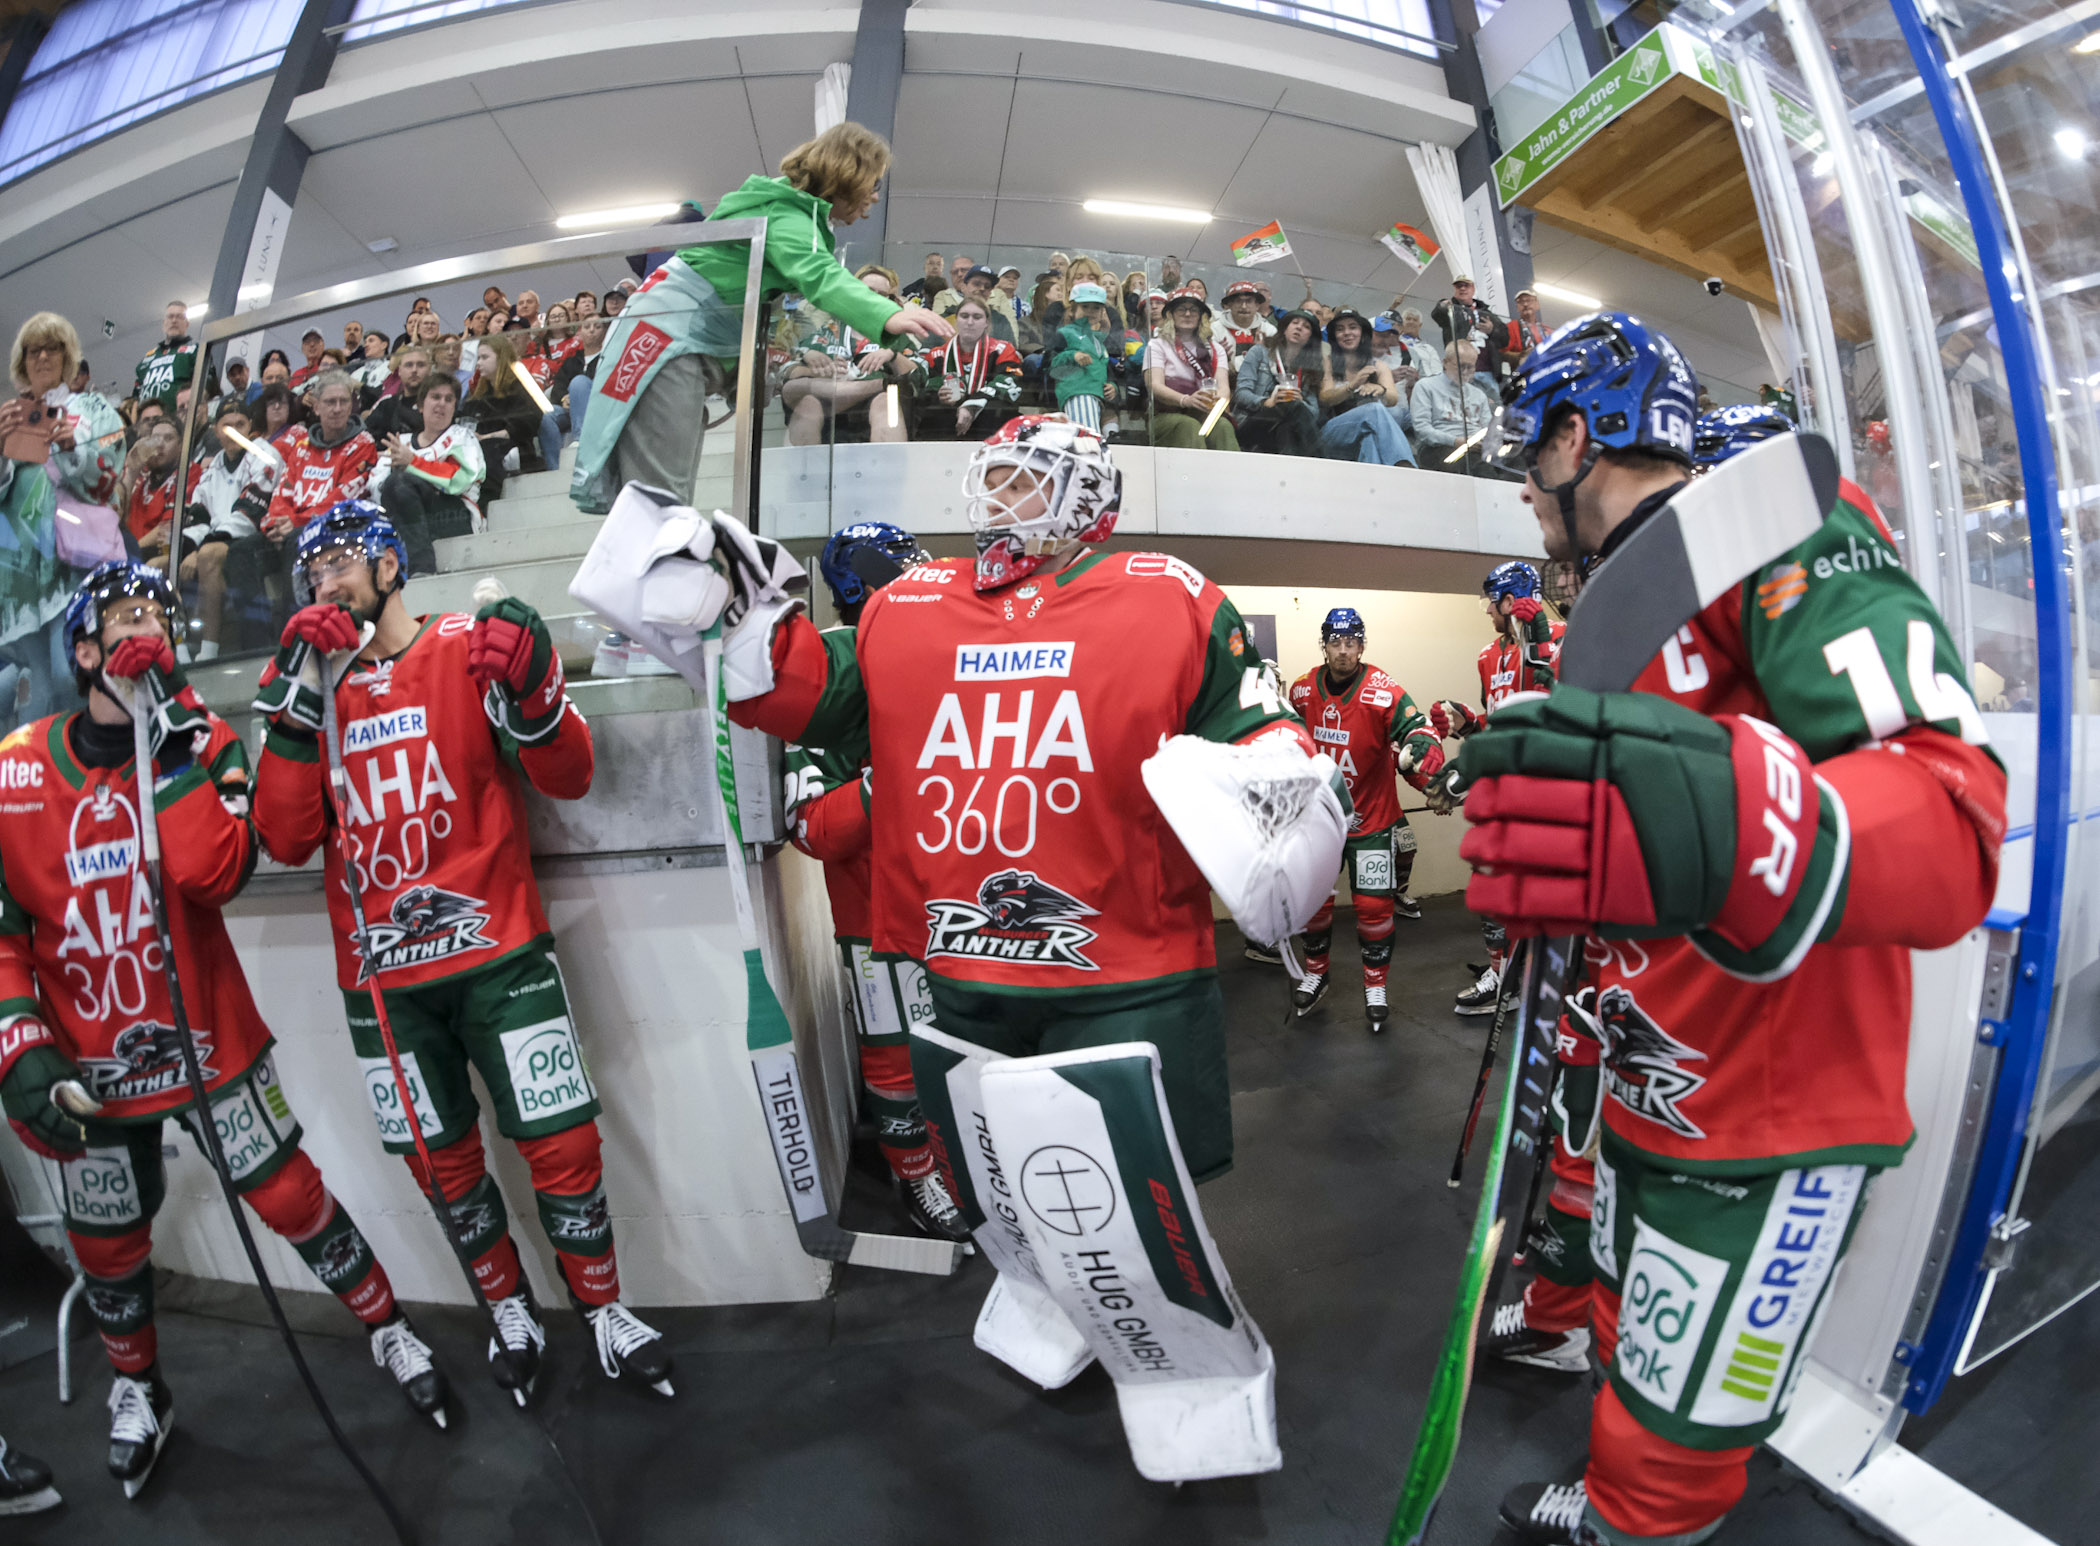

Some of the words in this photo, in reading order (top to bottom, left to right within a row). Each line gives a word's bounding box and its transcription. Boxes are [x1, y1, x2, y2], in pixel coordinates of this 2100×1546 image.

[1528, 129, 1558, 161] Jahn
[1558, 118, 1570, 135] &
[1569, 74, 1621, 126] Partner
[258, 234, 273, 273] LUNA
[842, 526, 882, 538] LEW
[1333, 622, 1349, 630] LEW
[959, 649, 1067, 674] HAIMER
[1822, 619, 1989, 746] 14
[347, 713, 424, 748] HAIMER
[916, 689, 1095, 773] AHA
[342, 740, 458, 827] AHA
[915, 775, 1081, 858] 360°
[1359, 874, 1388, 886] Bank
[1366, 861, 1388, 874] psd
[926, 903, 1091, 966] PANTHER
[910, 1003, 932, 1022] Ba
[529, 1041, 575, 1082] psd
[521, 1076, 585, 1113] Bank
[769, 1071, 815, 1192] TIERHOLD
[80, 1167, 129, 1194] psd
[73, 1192, 135, 1219] Bank
[1749, 1167, 1833, 1329] GREIF
[1061, 1252, 1085, 1293] AUDIT
[1077, 1249, 1134, 1311] HUG
[1113, 1317, 1176, 1372] GMBH
[1627, 1271, 1696, 1345] psd
